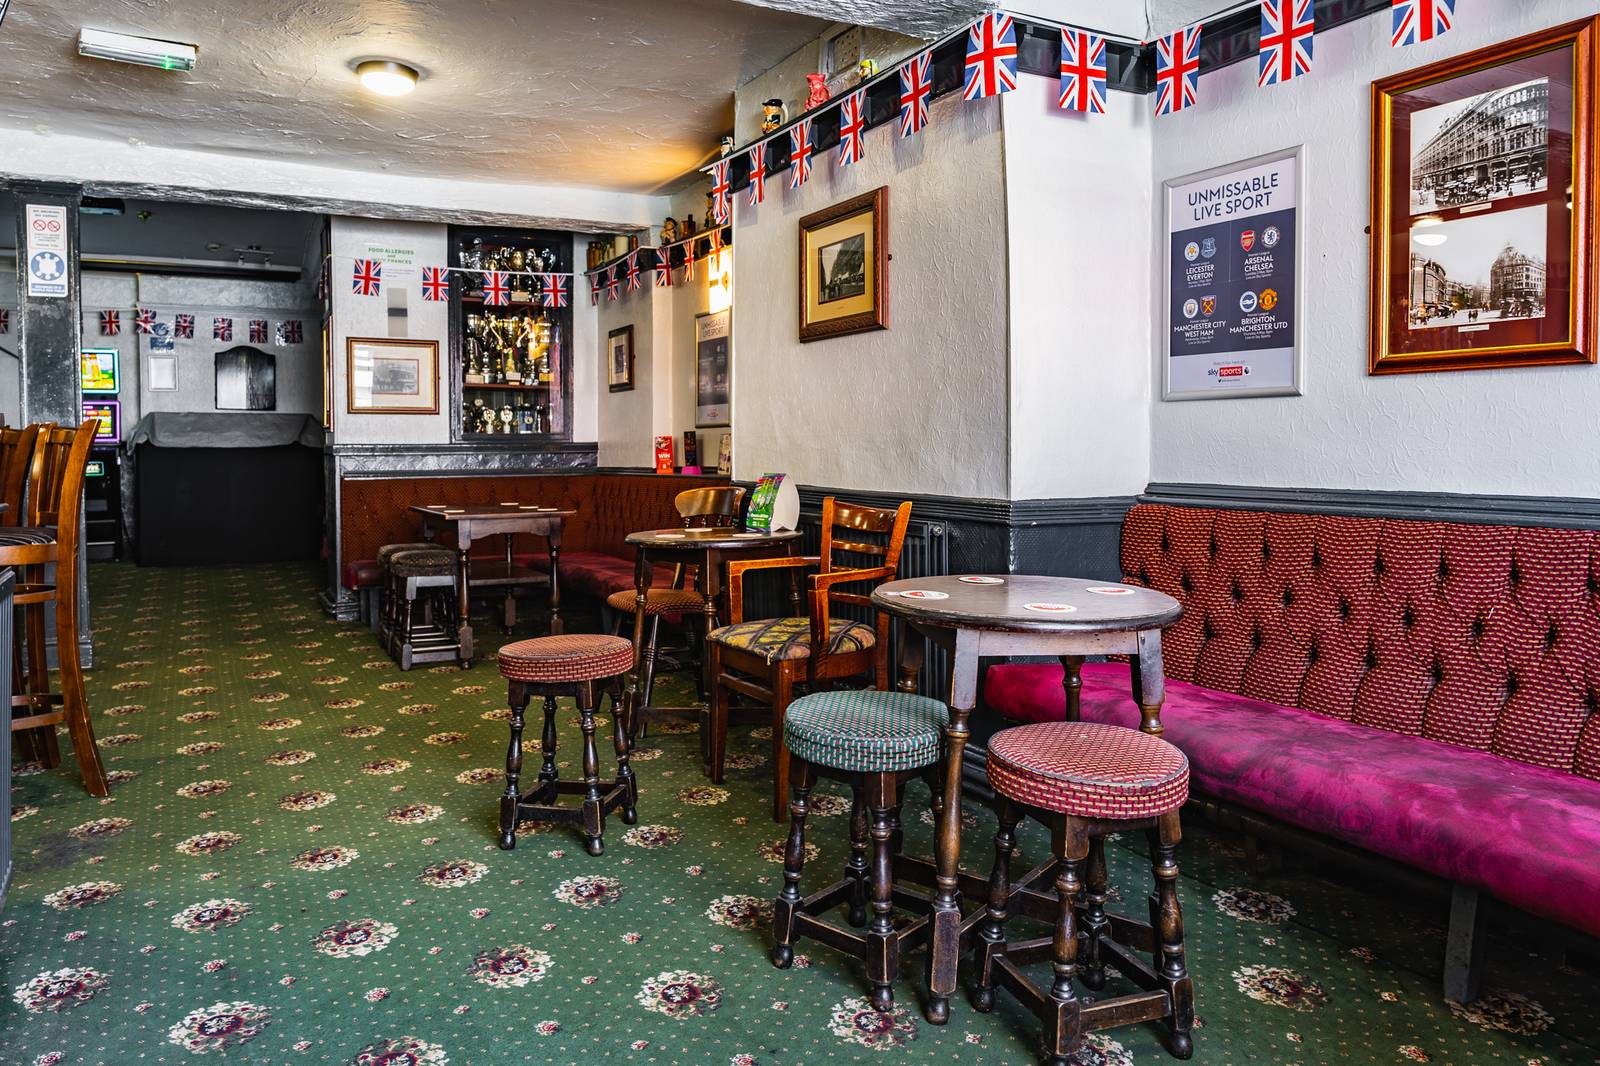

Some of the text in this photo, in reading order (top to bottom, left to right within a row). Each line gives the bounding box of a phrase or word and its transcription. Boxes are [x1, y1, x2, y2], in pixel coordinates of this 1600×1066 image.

[1188, 172, 1279, 206] UNMISSABLE
[1194, 192, 1272, 220] LIVE SPORT
[1244, 254, 1274, 265] ARSENAL
[1186, 264, 1215, 274] LEICESTER
[1244, 262, 1274, 272] CHELSEA
[1187, 272, 1213, 281] EVERTON
[1241, 315, 1275, 325] BRIGHTON
[1174, 323, 1212, 332] MANCHESTER
[1213, 320, 1226, 328] CITY
[1229, 323, 1273, 333] MANCHESTER
[1220, 368, 1241, 376] sports
